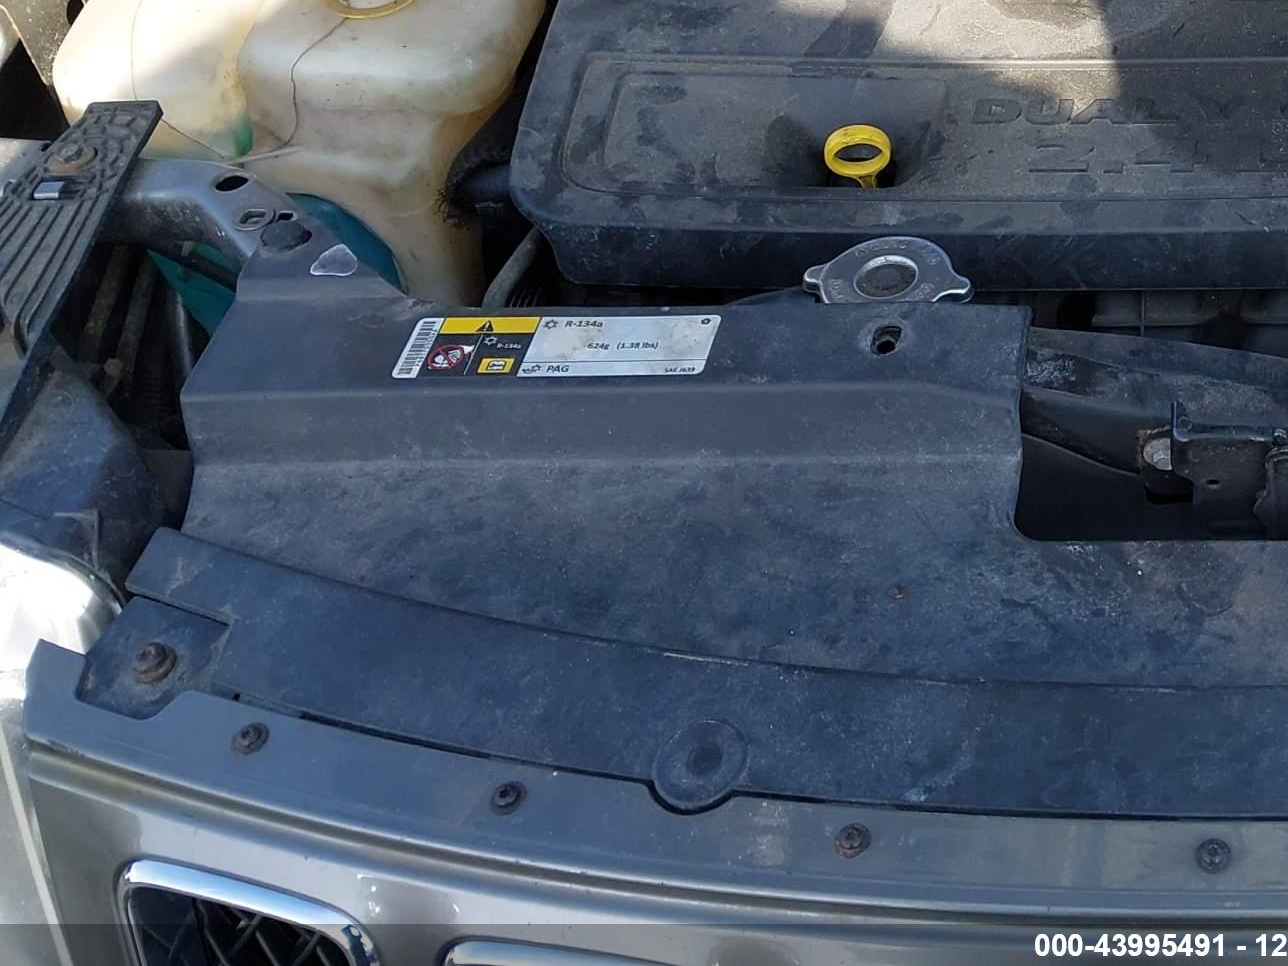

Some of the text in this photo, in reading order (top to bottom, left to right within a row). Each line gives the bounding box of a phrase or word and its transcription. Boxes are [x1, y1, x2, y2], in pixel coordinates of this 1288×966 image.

[970, 96, 1180, 125] DUAL
[564, 319, 604, 329] R-134a
[586, 341, 611, 351] 624g
[546, 364, 570, 374] PAG
